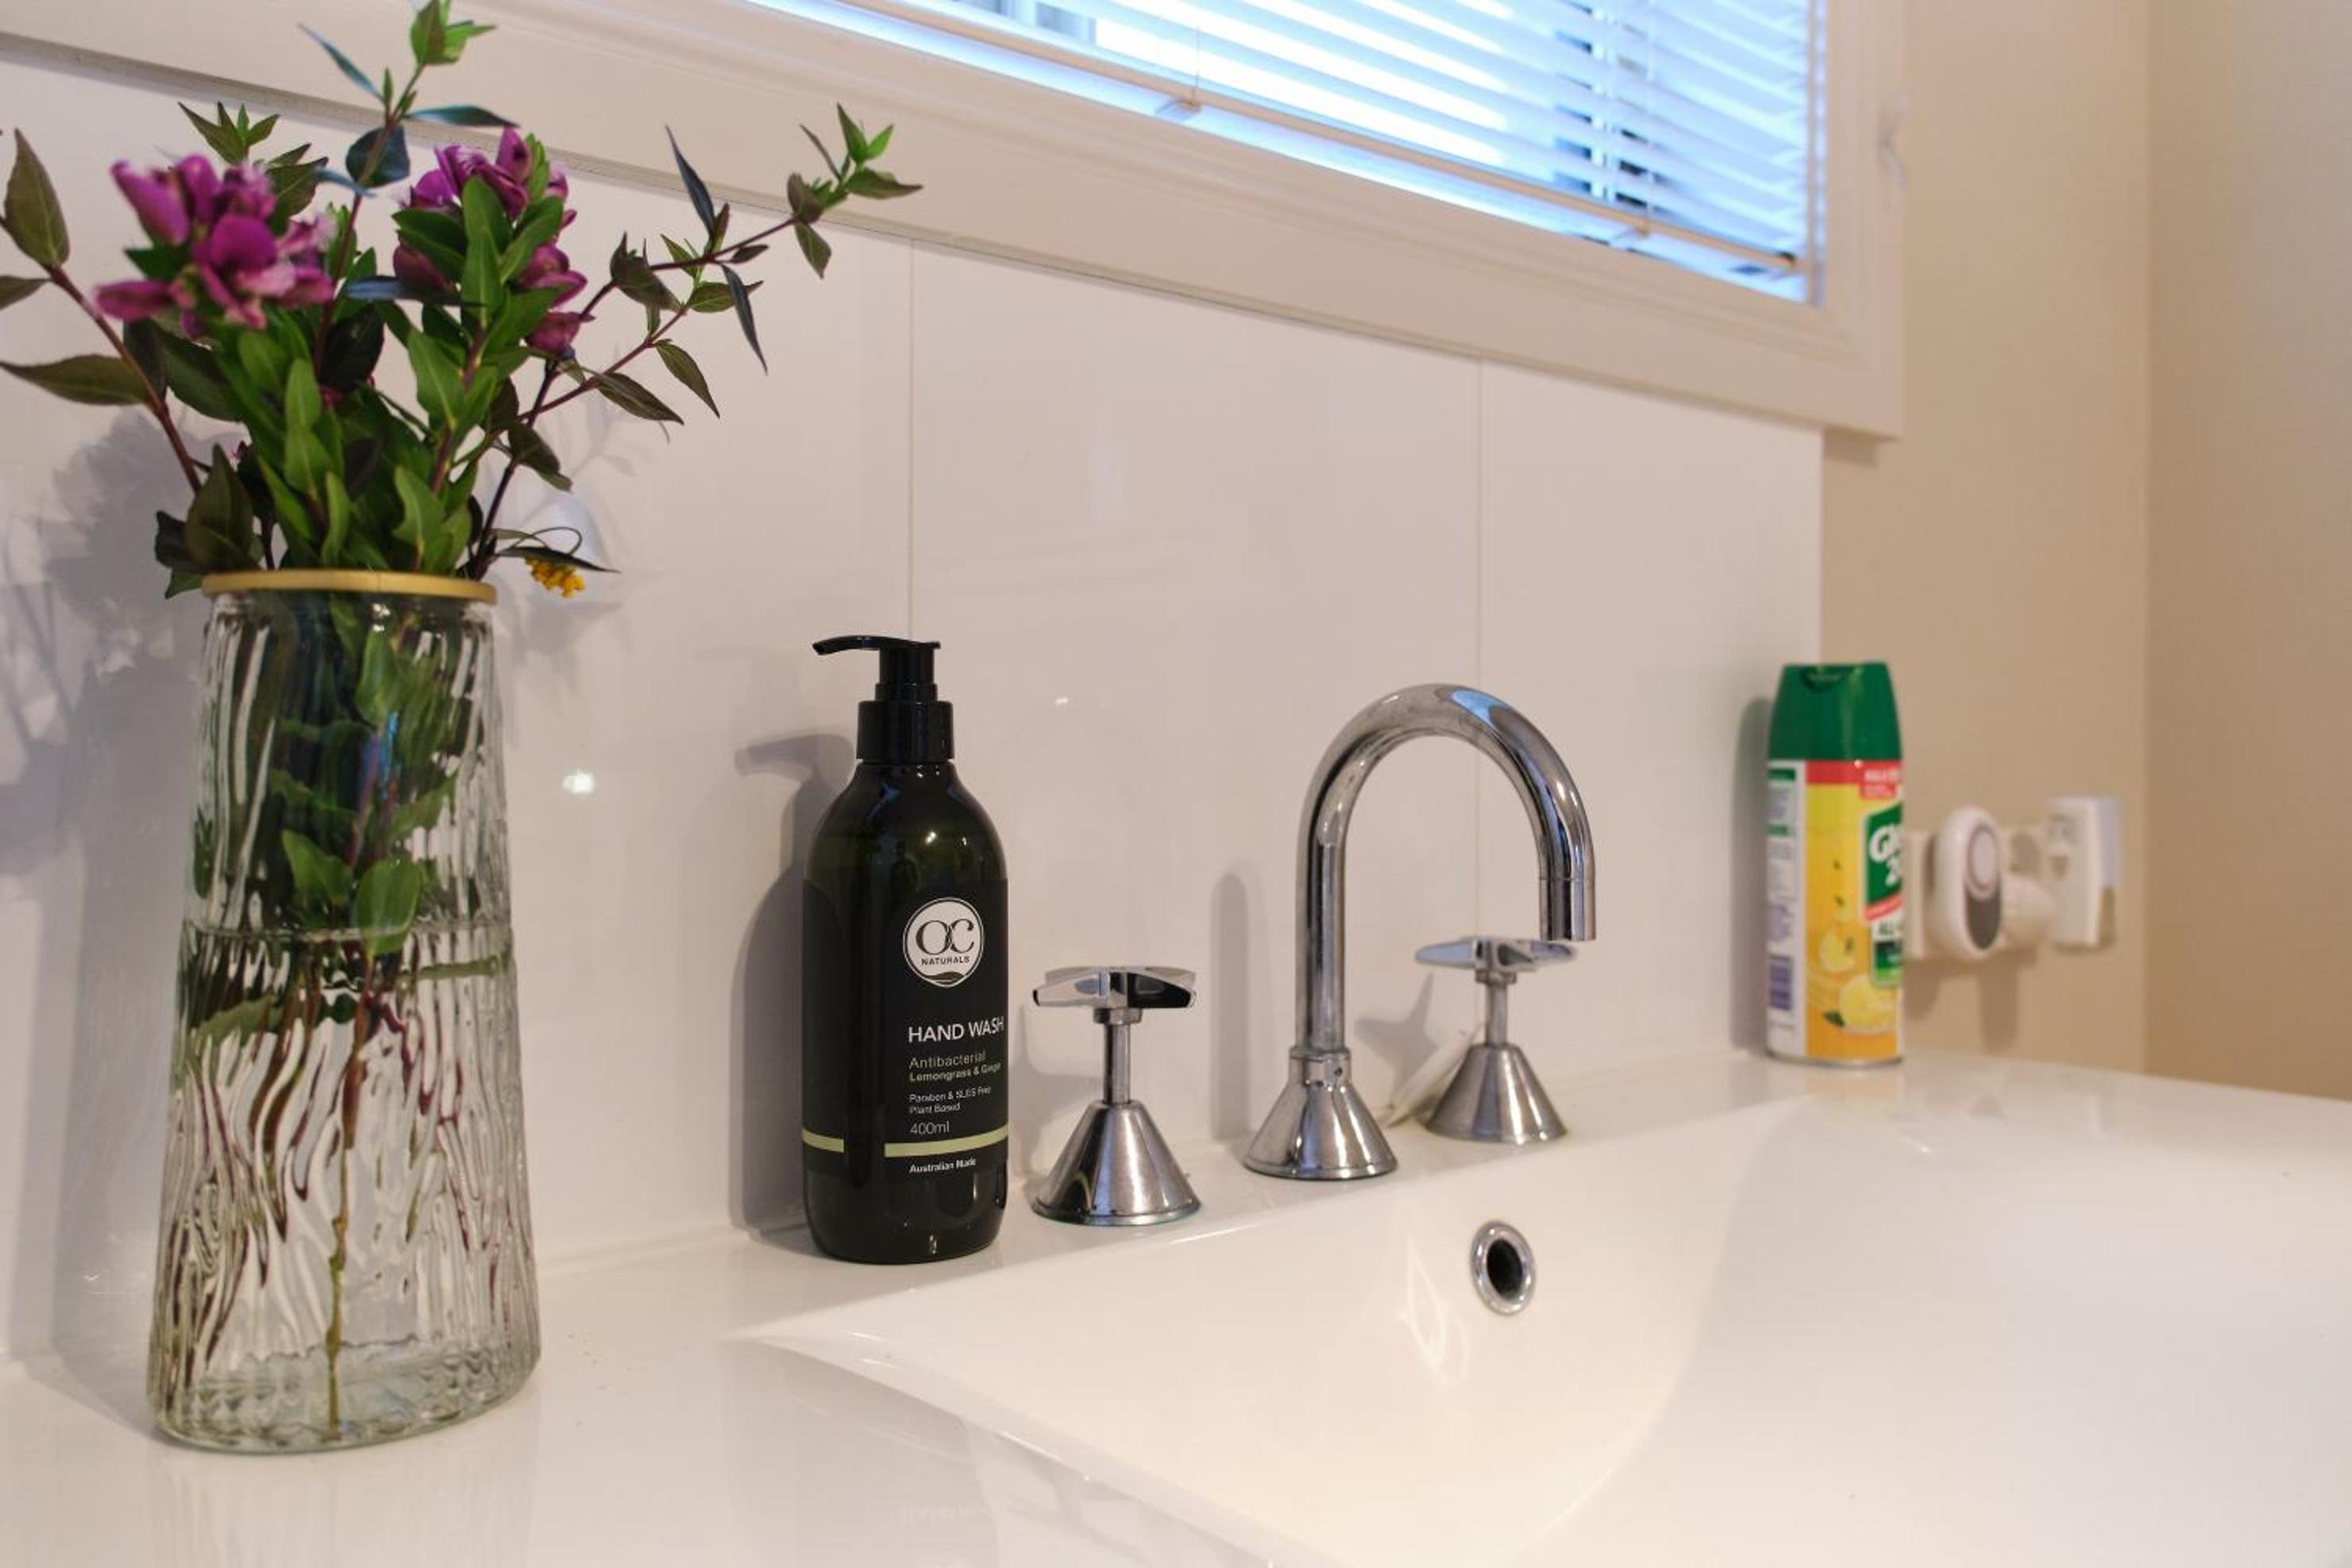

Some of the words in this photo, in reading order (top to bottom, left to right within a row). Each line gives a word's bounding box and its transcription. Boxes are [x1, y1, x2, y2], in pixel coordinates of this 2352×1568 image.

[916, 919, 974, 955] OC
[921, 956, 970, 965] NATURALS
[908, 1023, 965, 1042] HAND
[968, 1015, 1004, 1037] WASH
[909, 1049, 986, 1069] Antibacterial
[909, 1069, 971, 1082] Lemongrass
[910, 1120, 950, 1135] 400ml
[909, 1162, 954, 1173] Australian
[956, 1157, 977, 1169] Made
